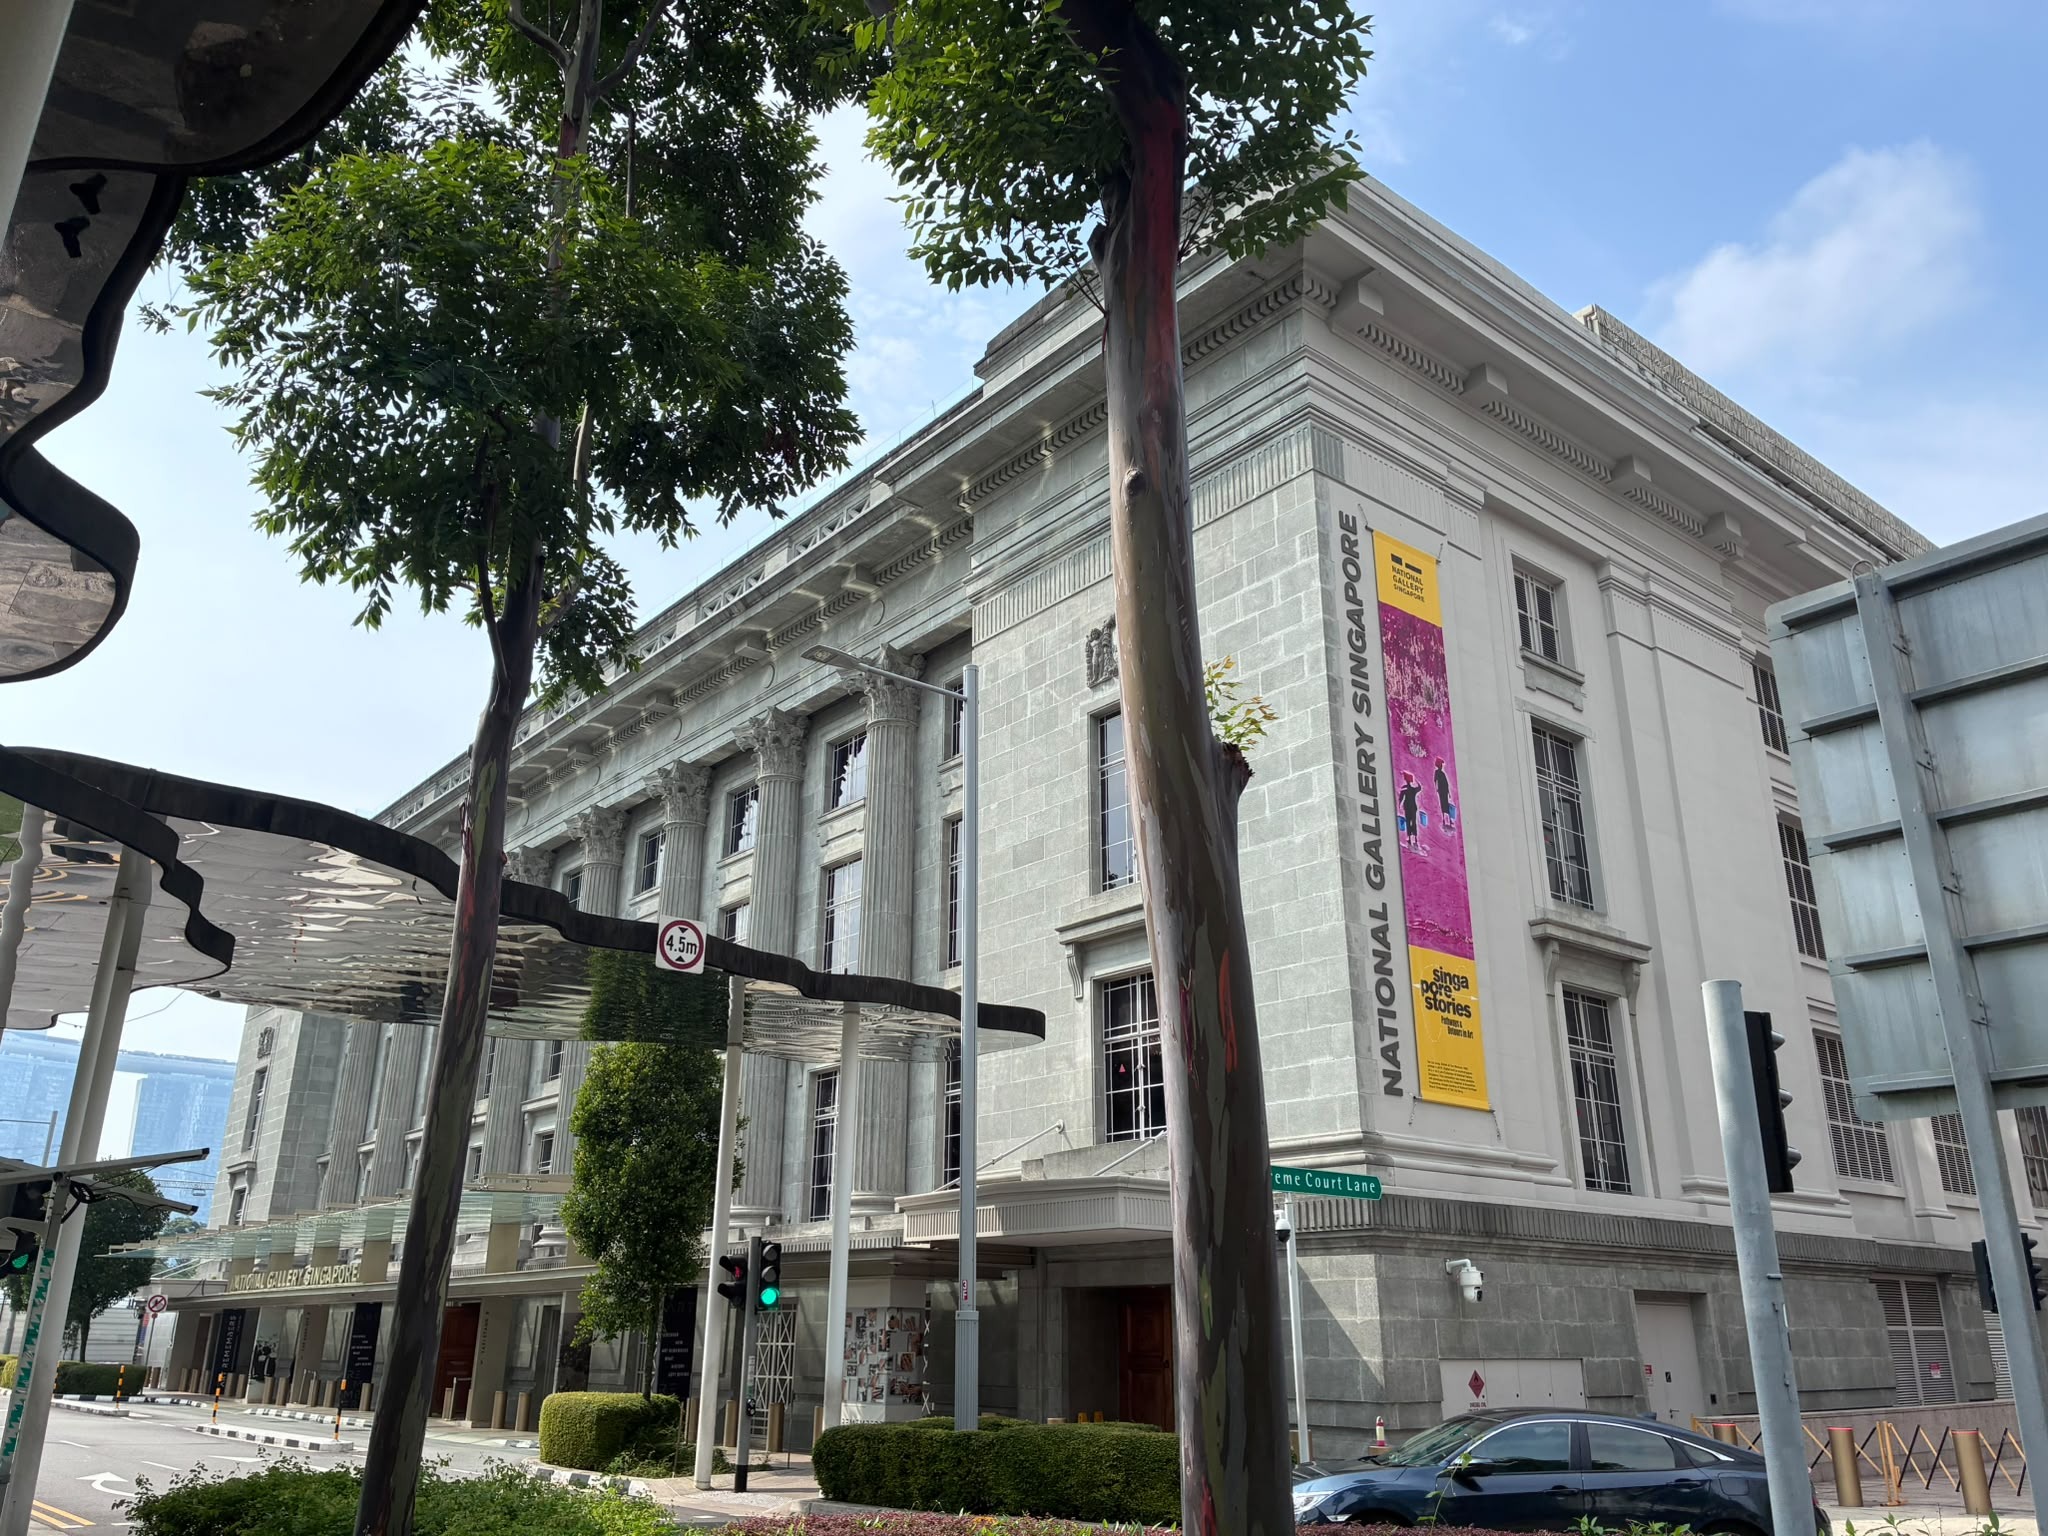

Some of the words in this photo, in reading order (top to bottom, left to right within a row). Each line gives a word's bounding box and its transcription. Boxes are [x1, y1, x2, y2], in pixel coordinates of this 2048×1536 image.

[1391, 565, 1424, 586] NATIONAL
[1392, 574, 1424, 594] GALLERY
[1393, 583, 1425, 603] SINGAPORE
[1339, 510, 1373, 717] SINGAPORE
[1354, 722, 1386, 892] GALLERY
[666, 934, 698, 955] 4.5m
[1420, 979, 1452, 998] pore
[1432, 966, 1469, 991] singa
[1369, 902, 1404, 1097] NATIONAL
[1424, 994, 1472, 1019] stories
[1271, 1173, 1301, 1186] eme
[1305, 1172, 1342, 1190] Court
[1346, 1176, 1376, 1193] Lane
[230, 1273, 265, 1291] NATIONAL
[266, 1268, 304, 1288] GALLERY
[303, 1263, 360, 1286] SINGAPORE
